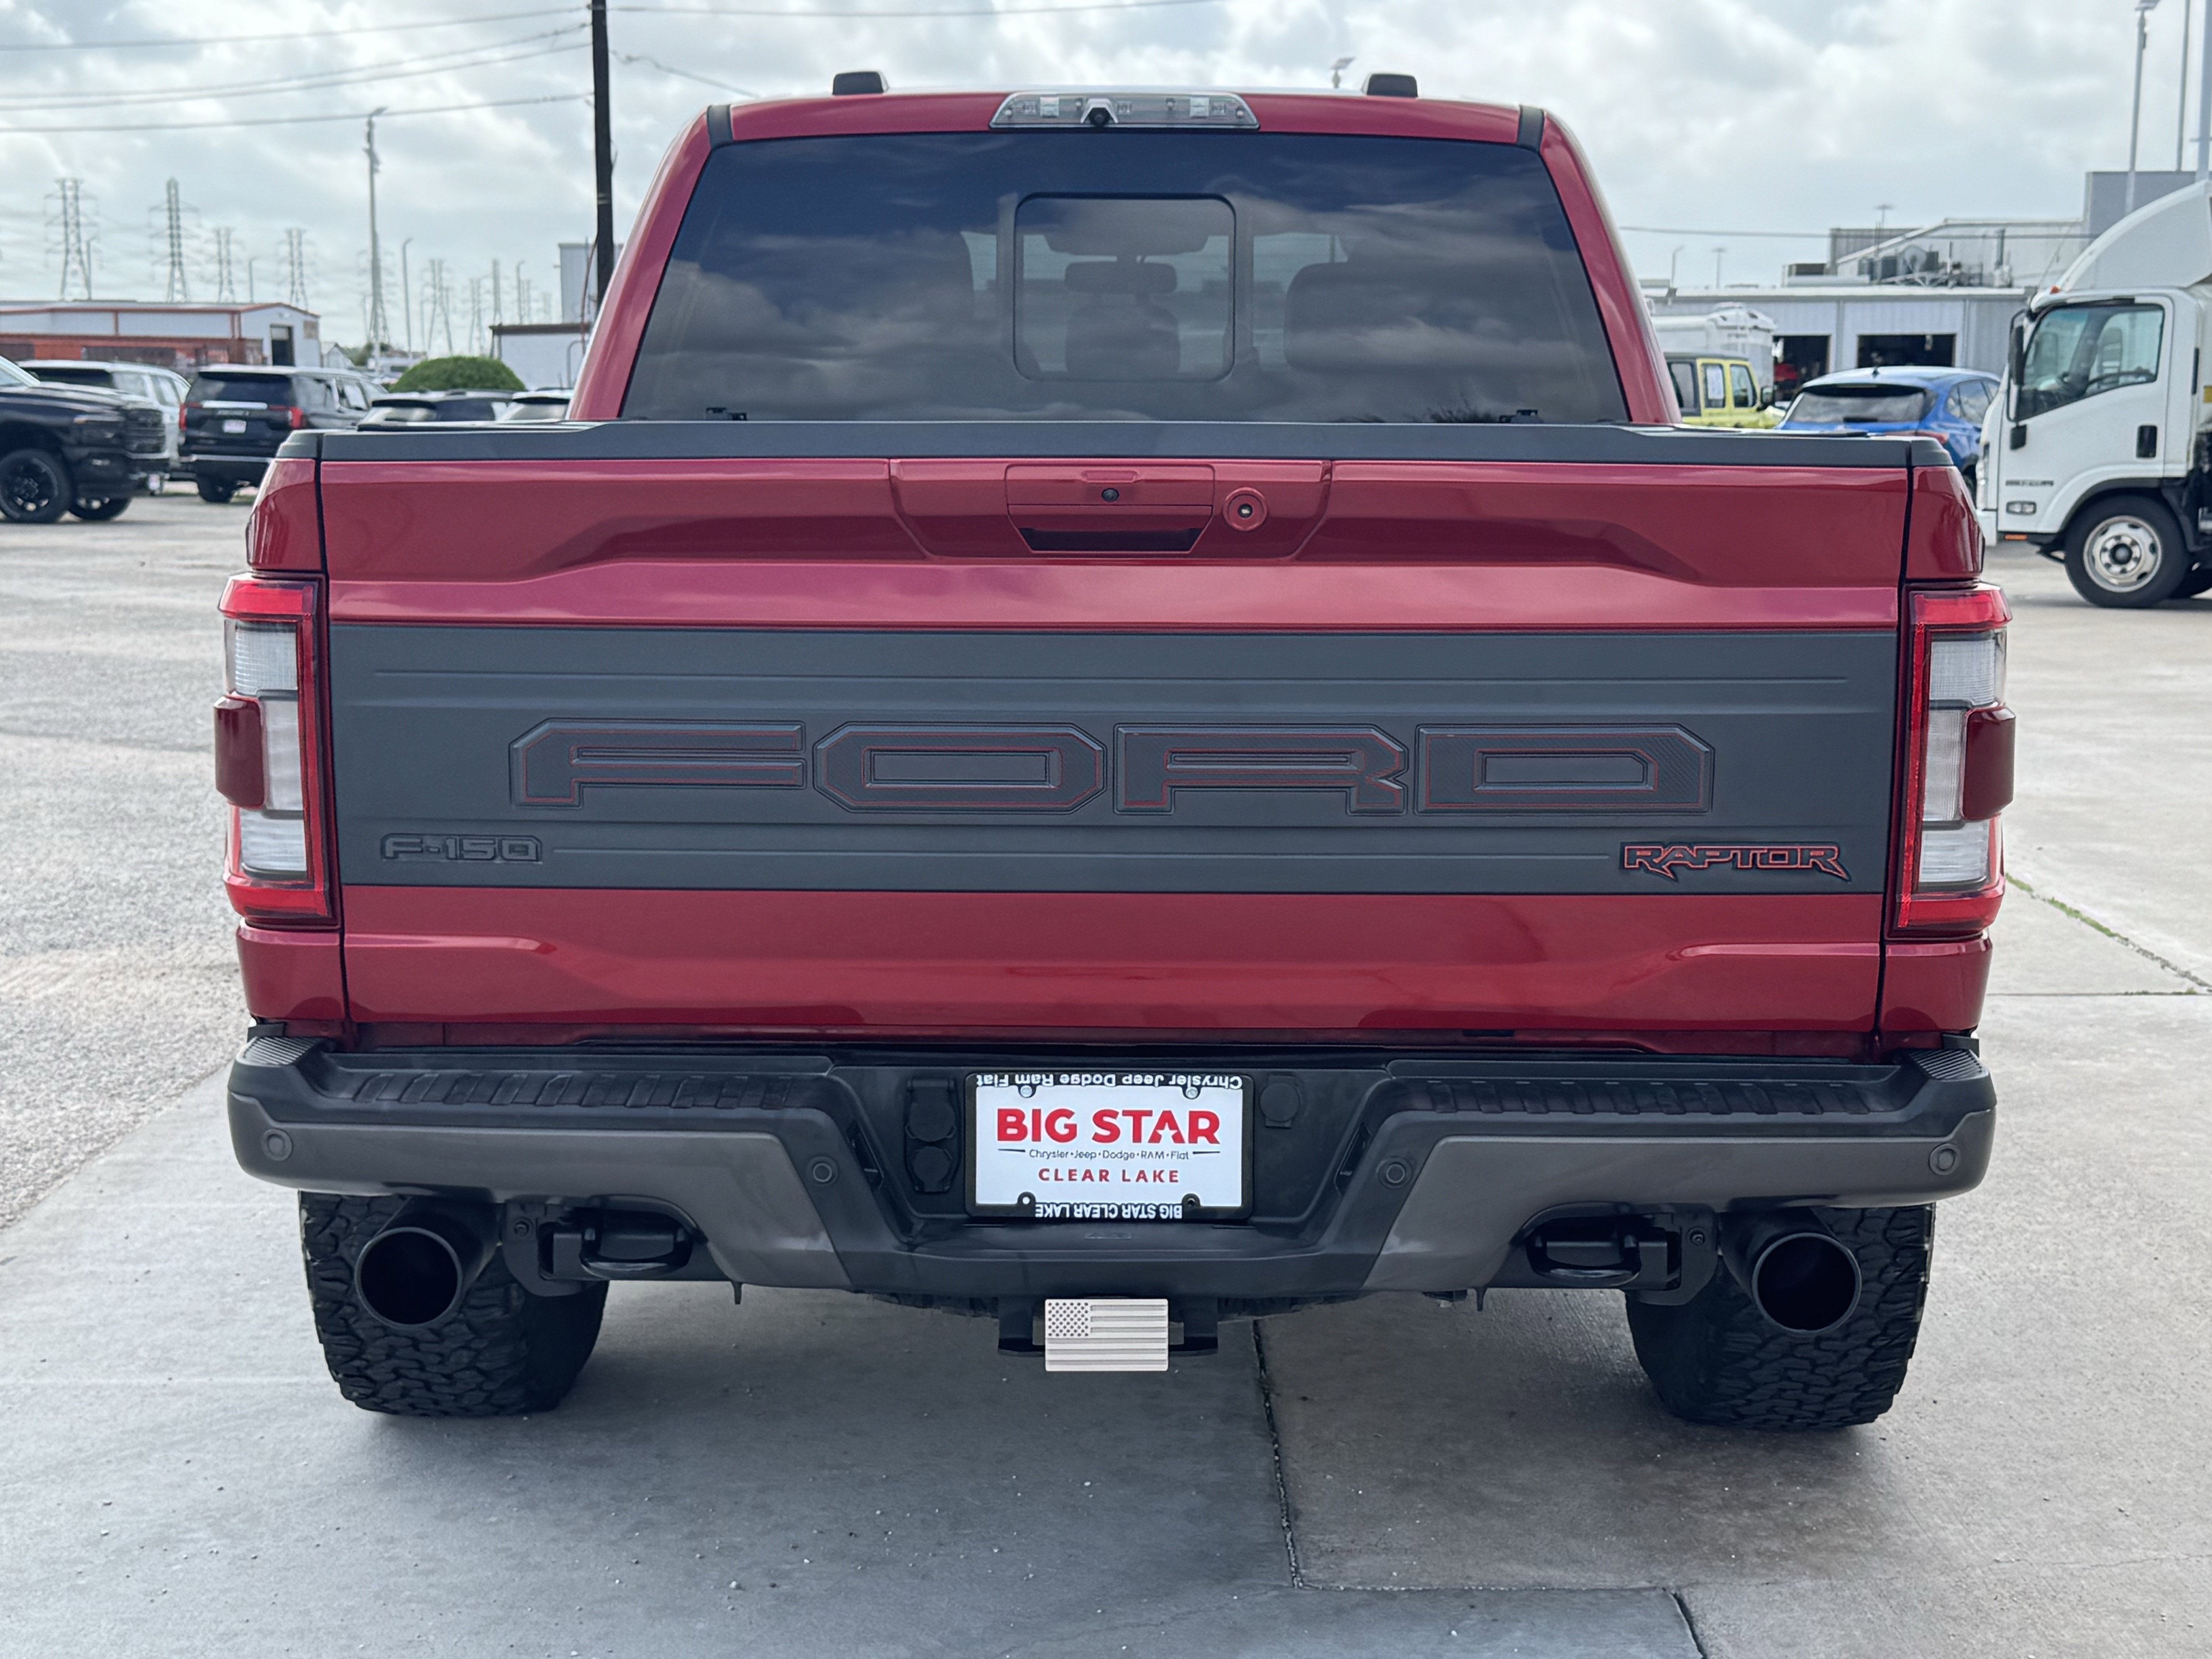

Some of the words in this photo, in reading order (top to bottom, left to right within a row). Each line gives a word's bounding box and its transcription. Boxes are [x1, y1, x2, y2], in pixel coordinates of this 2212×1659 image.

[510, 719, 1714, 814] FORD
[381, 833, 541, 861] F-150
[1622, 843, 1851, 881] RAPTOR
[1015, 1074, 1054, 1087] Ram
[1060, 1074, 1116, 1087] Dodge
[1122, 1074, 1164, 1087] Jeep
[1169, 1074, 1242, 1089] Chrysler
[997, 1108, 1077, 1143] BIG
[1092, 1109, 1221, 1144] STAR
[1039, 1168, 1110, 1182] CLEAR
[1121, 1170, 1179, 1182] LAKE
[1035, 1204, 1070, 1218] LAKE
[1074, 1204, 1118, 1219] CLEAR
[1122, 1204, 1156, 1219] STAR
[1159, 1204, 1182, 1219] BIG
